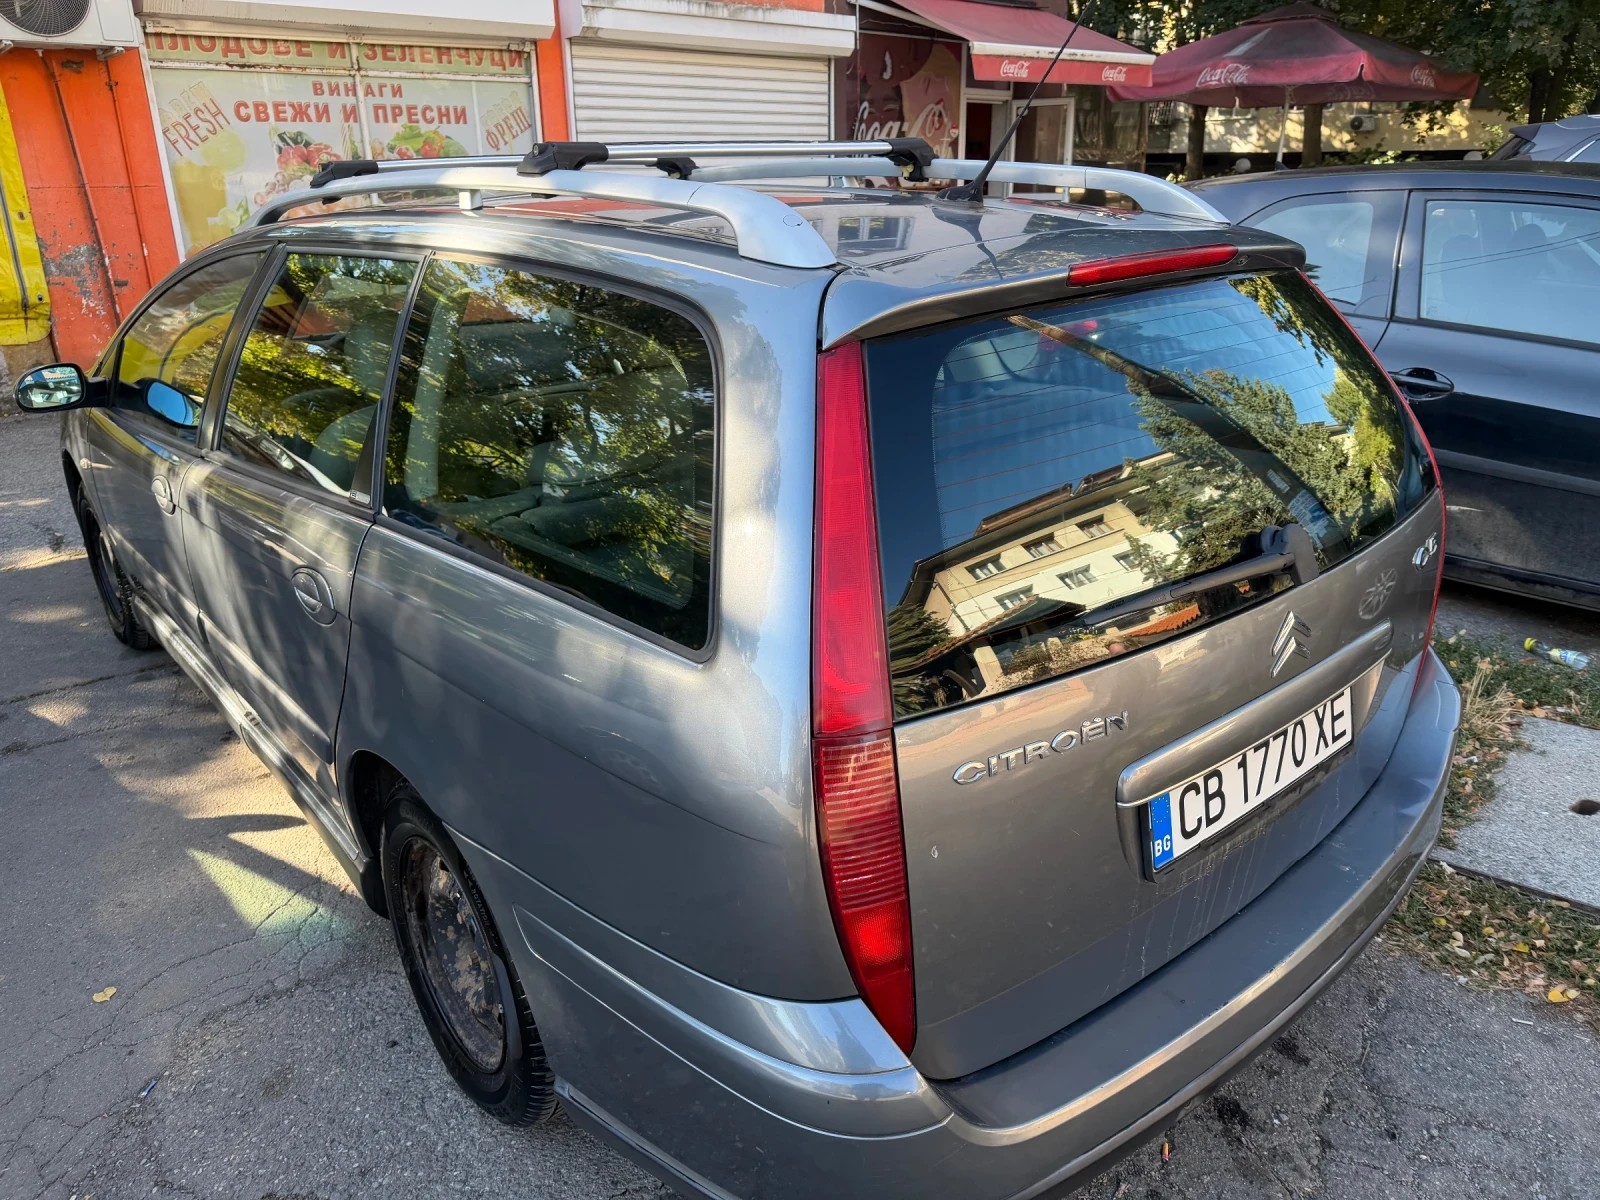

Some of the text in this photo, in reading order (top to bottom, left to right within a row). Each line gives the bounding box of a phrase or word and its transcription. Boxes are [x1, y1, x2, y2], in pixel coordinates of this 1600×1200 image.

[327, 41, 347, 59] И
[363, 44, 523, 71] ЗЕЛЕНЧУЦИ
[1000, 59, 1031, 78] Coca-Cola
[1101, 65, 1127, 81] Coca-Cola
[1196, 63, 1251, 87] Coca-Cola
[311, 80, 404, 98] ВИНАГИ
[233, 100, 331, 123] СВЕЖИ
[341, 103, 358, 123] И
[372, 103, 468, 125] ПРЕСНИ
[161, 97, 231, 157] FRESH
[485, 105, 532, 151] ФРЕШ
[1412, 531, 1438, 571] C5
[953, 710, 1128, 785] CITROËN
[1179, 691, 1347, 841] CB 1770 XE
[1154, 834, 1171, 858] BG
